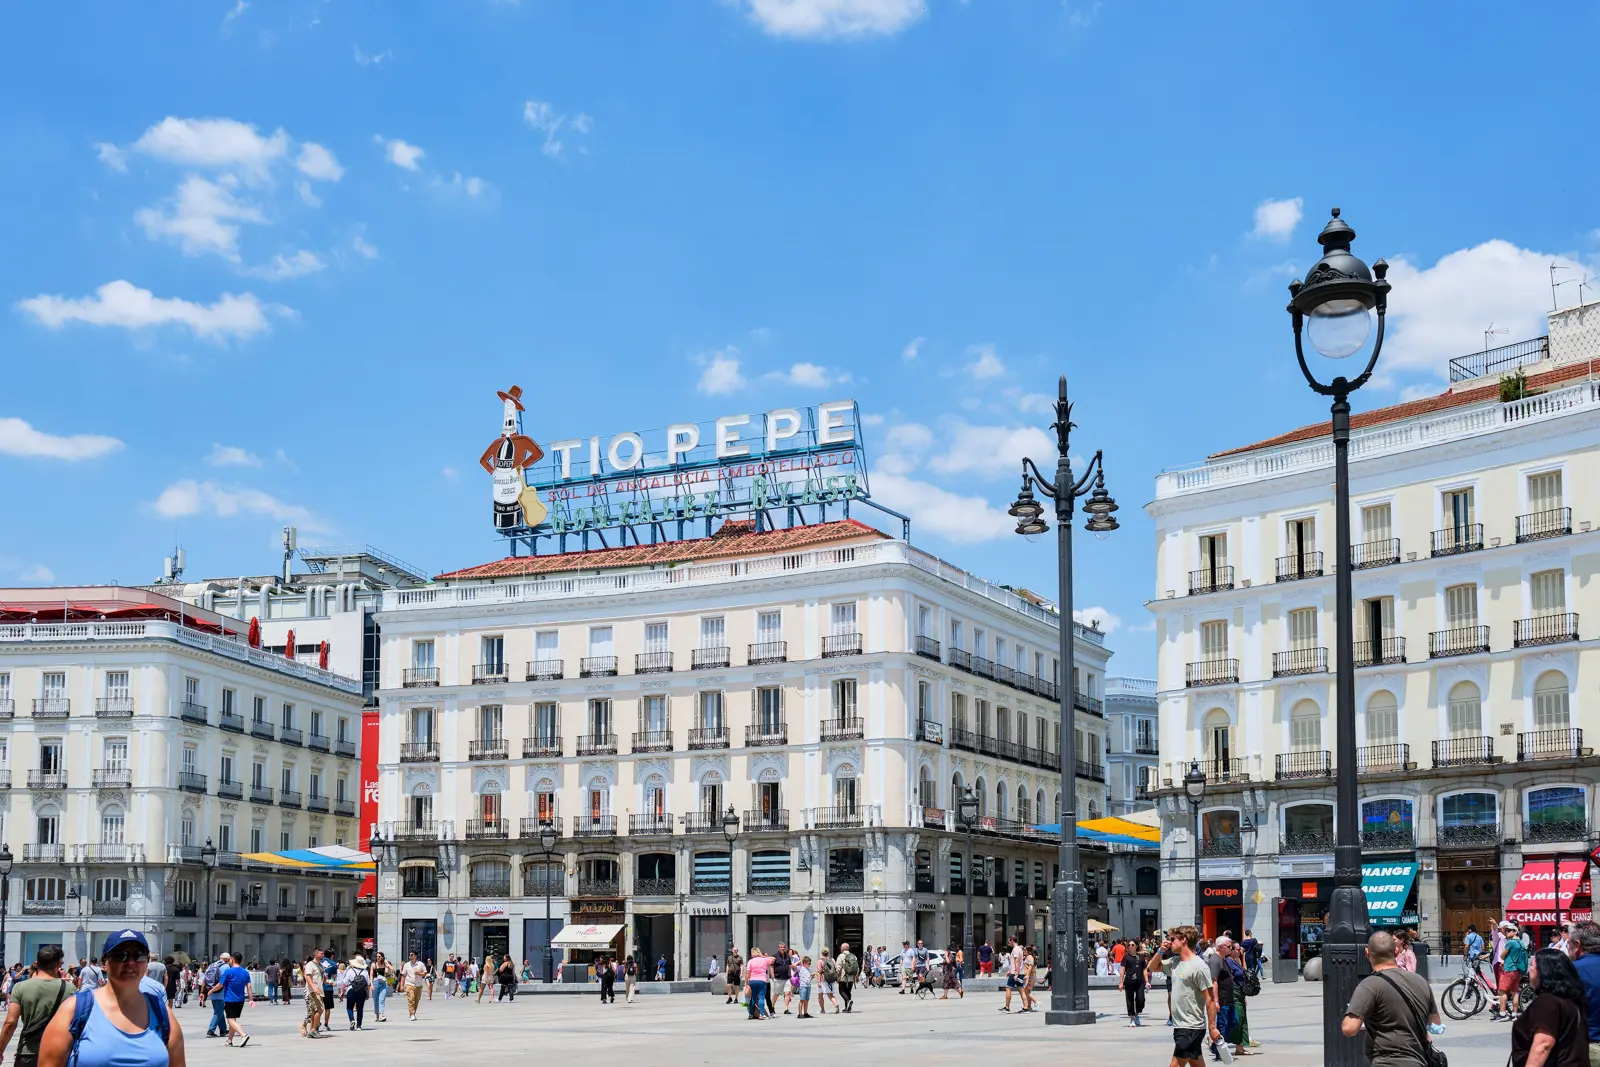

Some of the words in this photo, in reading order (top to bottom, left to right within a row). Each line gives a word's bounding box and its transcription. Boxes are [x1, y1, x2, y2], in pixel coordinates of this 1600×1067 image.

[551, 432, 644, 480] TIO
[668, 399, 855, 466] PEPE
[548, 488, 581, 502] SOL
[587, 484, 607, 497] DE
[616, 471, 710, 493] ANDALUCIA
[718, 451, 854, 480] EMBOTELLADO
[551, 490, 717, 534] GONZALEZ
[752, 474, 858, 510] BYASS
[1362, 867, 1411, 876] HANGE
[1204, 887, 1238, 899] Orange
[1362, 885, 1404, 893] ANSFER
[475, 904, 504, 913] PRIMOR
[580, 904, 613, 913] PALAZZO
[692, 907, 728, 915] SEPHORA
[826, 905, 862, 914] SEPHORA
